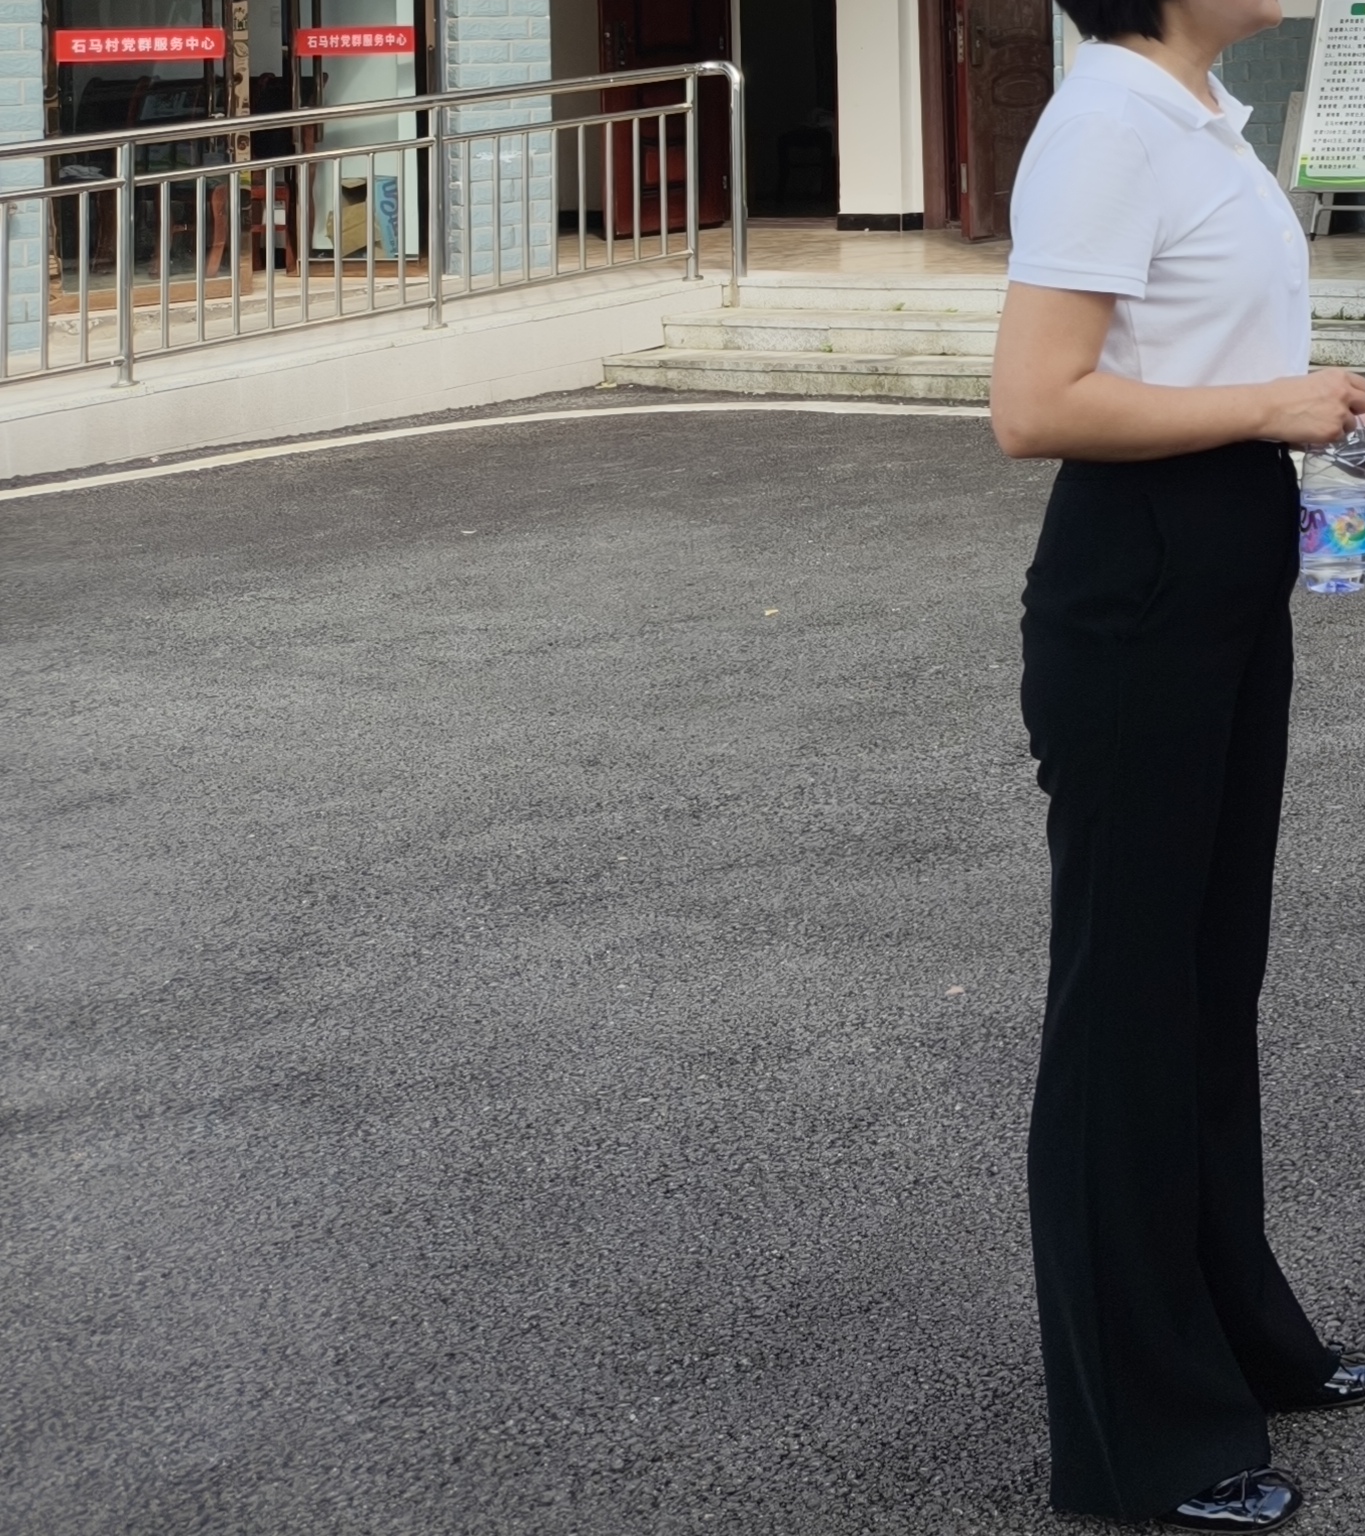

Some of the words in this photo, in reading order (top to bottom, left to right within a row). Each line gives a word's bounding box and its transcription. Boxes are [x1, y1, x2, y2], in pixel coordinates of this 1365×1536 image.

[71, 37, 215, 53] 石马村党群服务中心
[307, 33, 407, 48] 石马村党群服务中心
